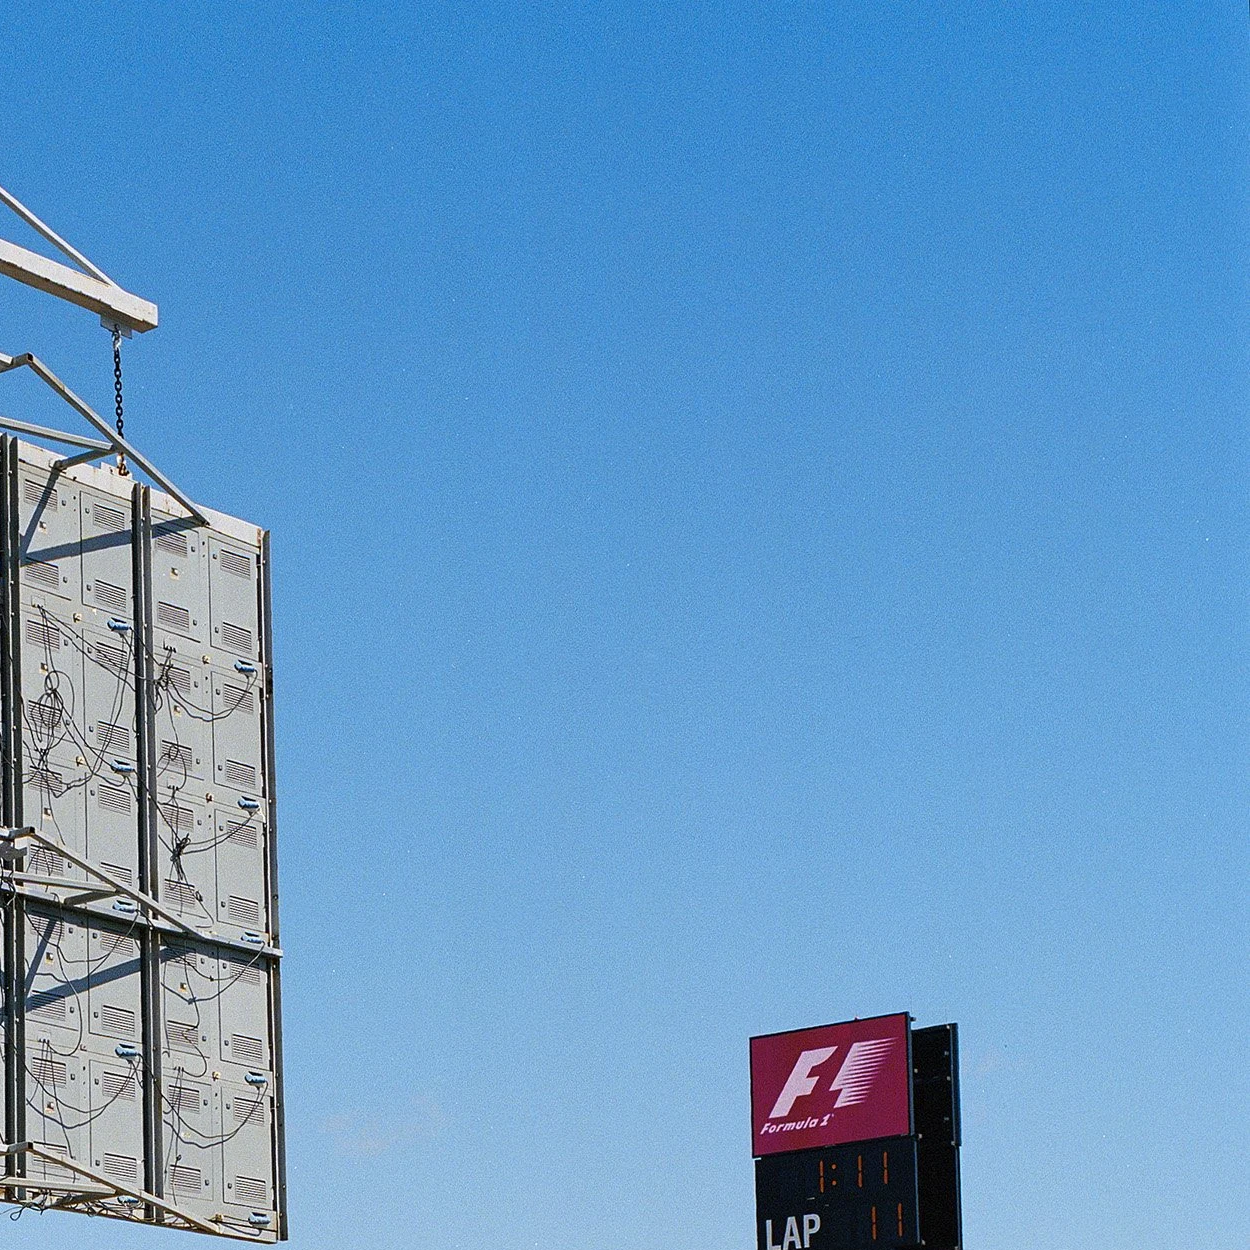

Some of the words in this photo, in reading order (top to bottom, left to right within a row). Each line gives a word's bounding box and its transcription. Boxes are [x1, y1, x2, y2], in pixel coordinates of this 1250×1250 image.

[768, 1036, 899, 1119] F1
[759, 1116, 820, 1135] Formula
[819, 1151, 889, 1194] 1:11
[871, 1202, 903, 1241] 11
